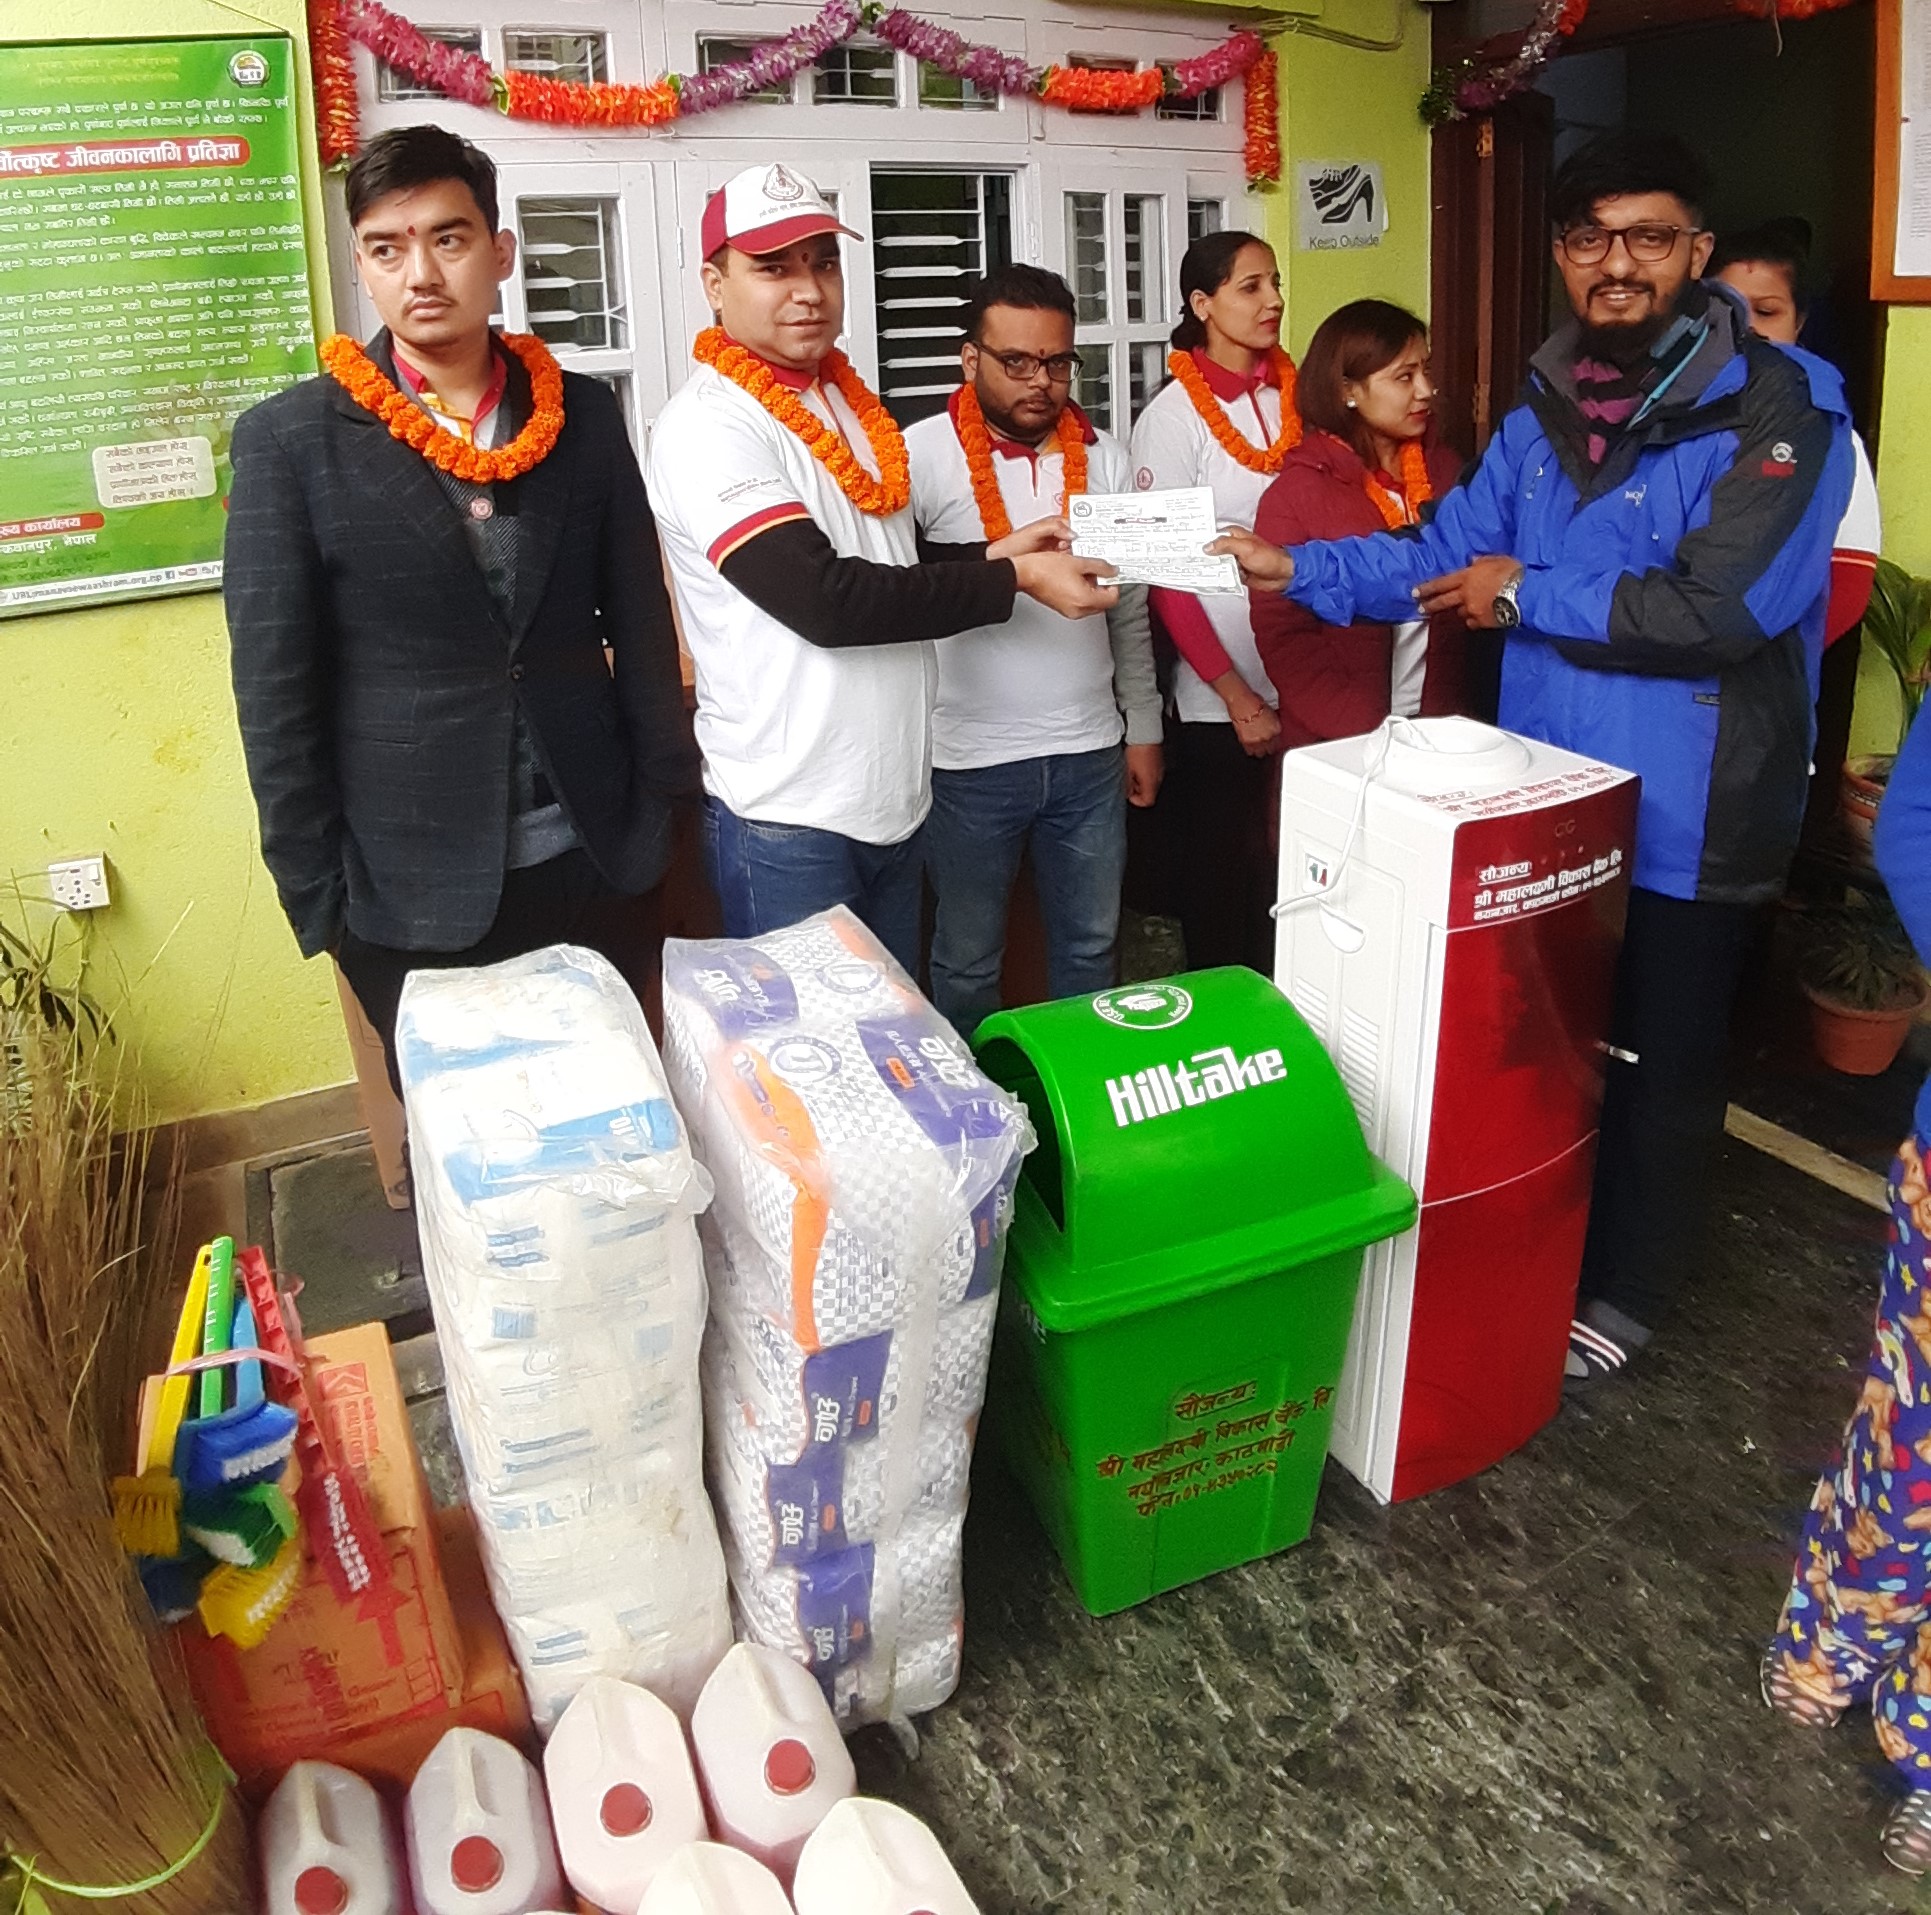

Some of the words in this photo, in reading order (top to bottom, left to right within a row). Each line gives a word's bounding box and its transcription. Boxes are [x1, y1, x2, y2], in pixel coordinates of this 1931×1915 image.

[186, 139, 240, 163] प्रतिज्ञा
[1309, 236, 1337, 249] Keep
[1340, 234, 1379, 247] Outside
[25, 518, 81, 532] कार्यालय
[63, 534, 97, 546] नेपाल
[1555, 819, 1576, 837] CG
[1474, 889, 1493, 909] श्री
[1558, 864, 1592, 888] विकास
[1105, 1047, 1287, 1127] Hilltake
